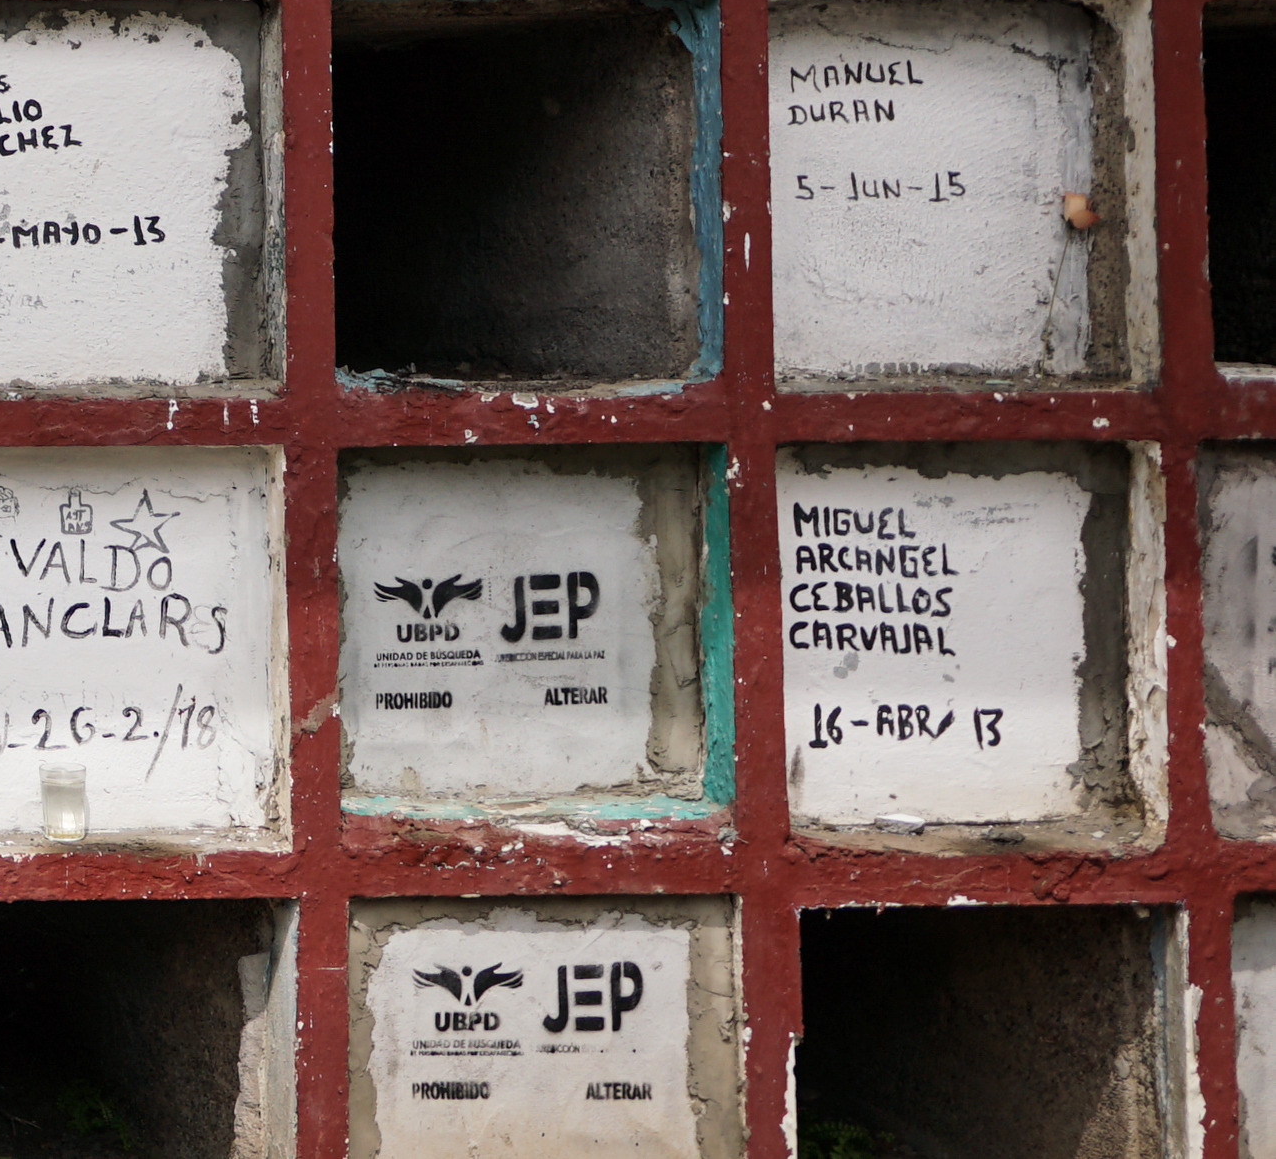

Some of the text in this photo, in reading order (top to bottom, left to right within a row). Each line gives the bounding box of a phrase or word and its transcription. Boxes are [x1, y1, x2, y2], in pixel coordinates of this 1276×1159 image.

[790, 59, 924, 93] MANUEL
[787, 99, 895, 126] DURAN
[792, 501, 916, 541] MIGUEL
[795, 542, 959, 579] ARCANGEL
[500, 572, 599, 643] JEP
[789, 580, 953, 618] CEBALLOS
[396, 623, 459, 643] UBPD
[788, 619, 956, 657] CARVAJAL
[376, 652, 413, 661] UNIDAD
[416, 652, 428, 660] DE
[375, 686, 608, 710] PROHIBIDO ALTERAR
[543, 961, 643, 1032] JEP
[434, 1011, 500, 1032] UBPD
[412, 1081, 653, 1101] PROHIBIDO ALTERAR
